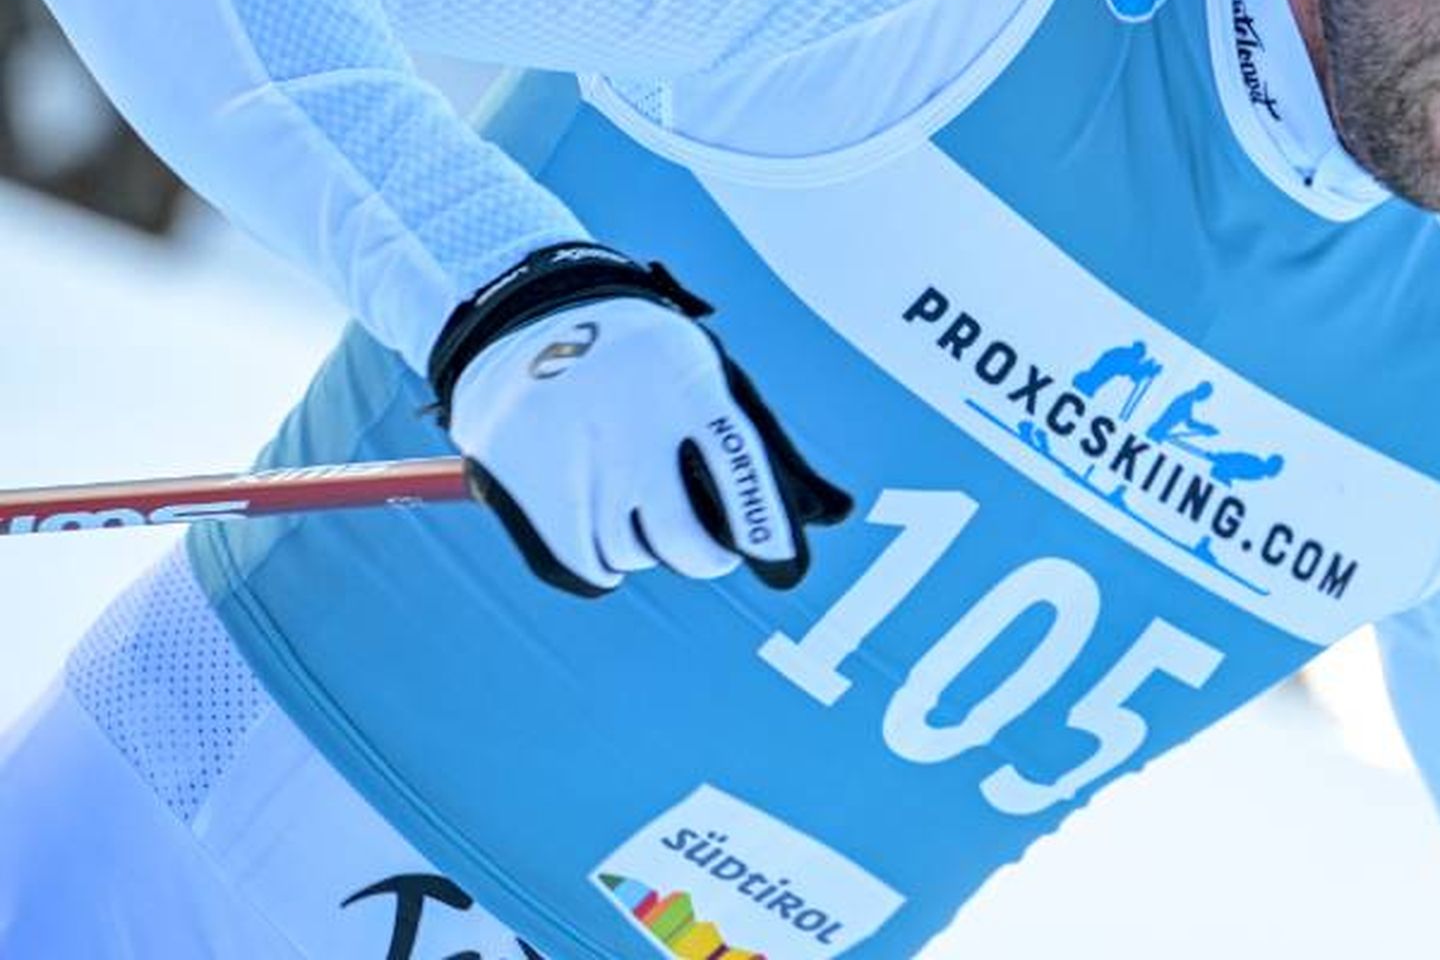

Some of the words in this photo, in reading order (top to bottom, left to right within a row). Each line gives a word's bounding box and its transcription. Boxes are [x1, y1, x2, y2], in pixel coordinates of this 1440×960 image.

[707, 416, 771, 545] NORTHUG
[901, 286, 1359, 600] PROXCSKIING.COM
[756, 488, 1226, 816] 105
